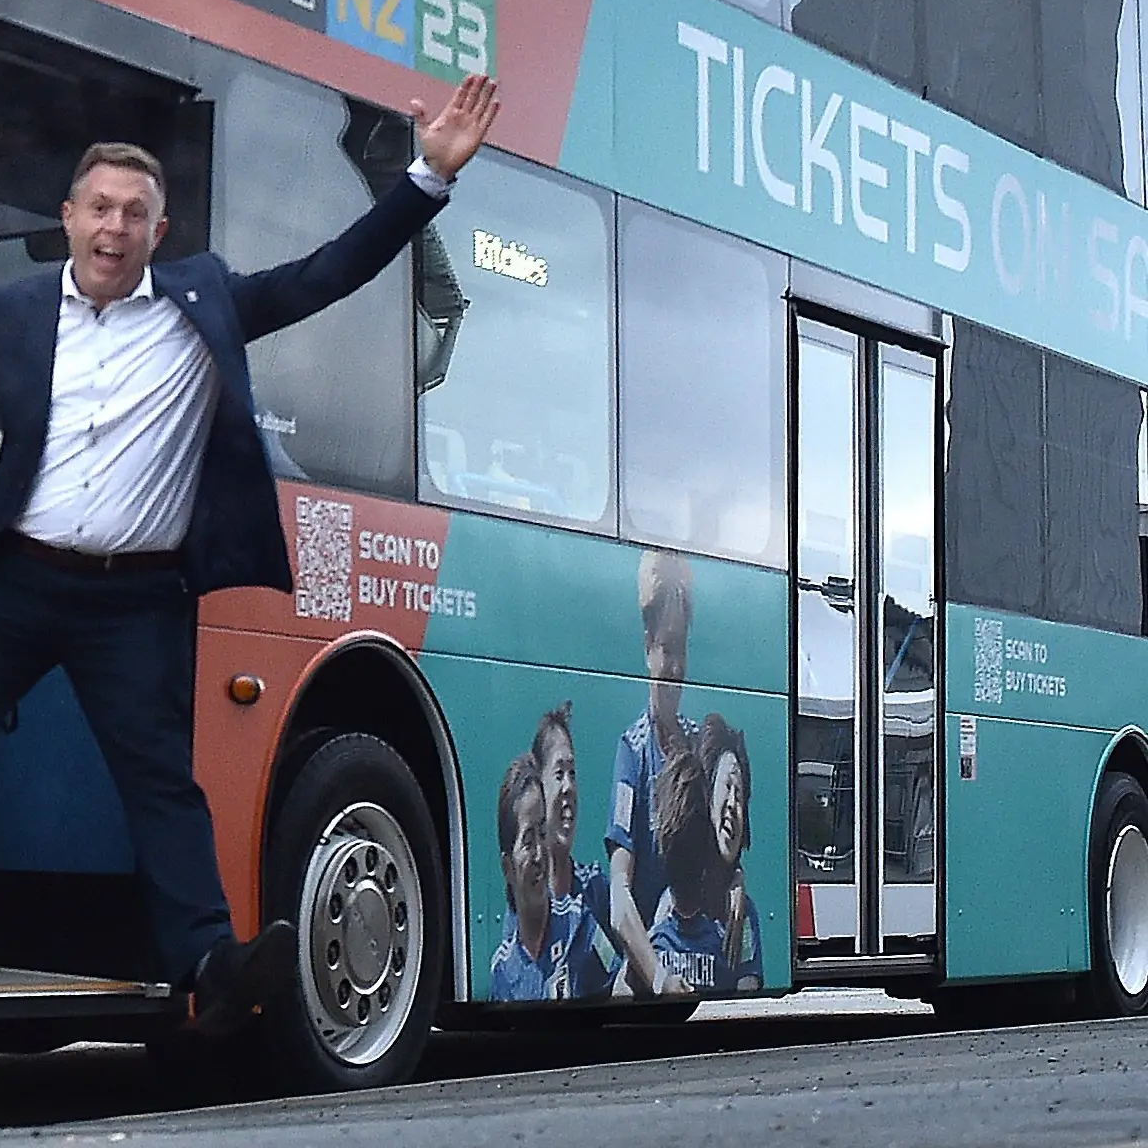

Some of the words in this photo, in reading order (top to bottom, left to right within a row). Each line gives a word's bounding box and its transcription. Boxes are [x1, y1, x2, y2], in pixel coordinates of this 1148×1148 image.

[677, 21, 972, 273] TICKETS
[990, 172, 1072, 312] ON
[358, 530, 411, 566] SCAN
[414, 538, 440, 570] TO
[358, 574, 397, 608] BUY
[401, 581, 477, 619] TICKETS
[1005, 639, 1033, 661] SCAN
[1035, 642, 1048, 664] TO
[1005, 669, 1026, 692] BUY
[1027, 673, 1066, 697] TICKETS
